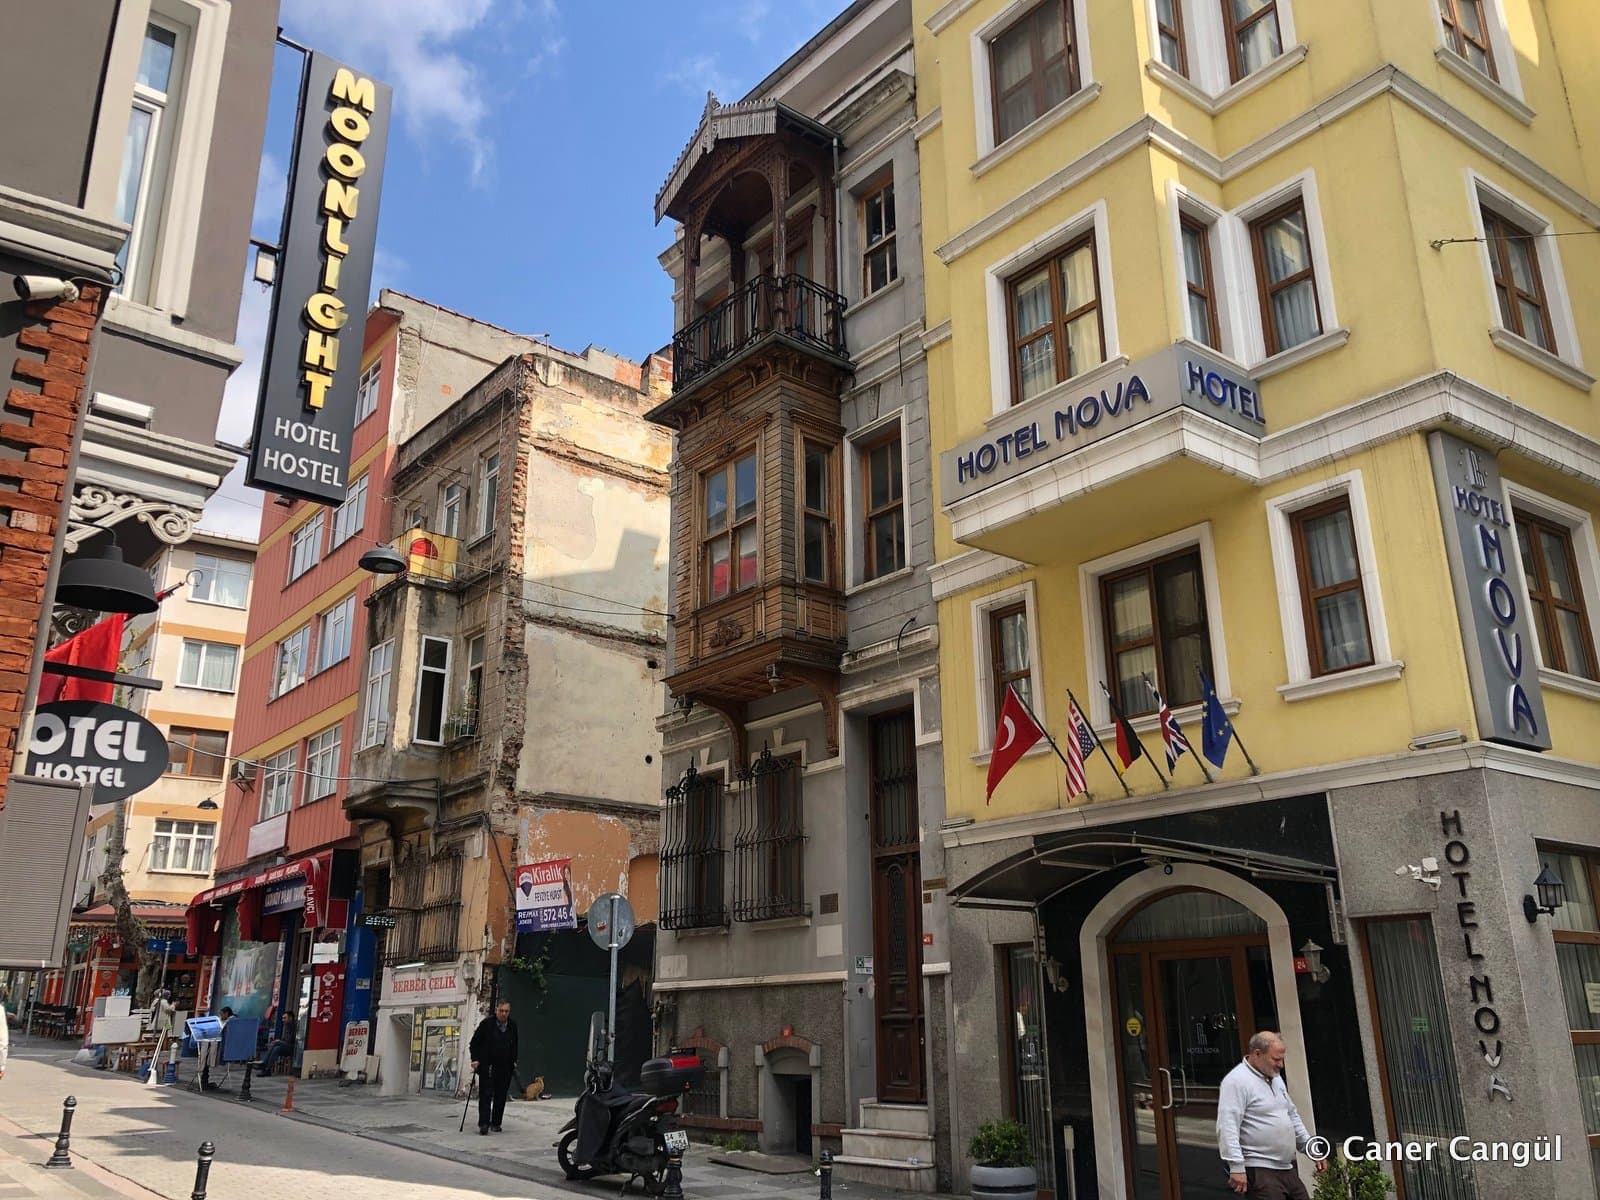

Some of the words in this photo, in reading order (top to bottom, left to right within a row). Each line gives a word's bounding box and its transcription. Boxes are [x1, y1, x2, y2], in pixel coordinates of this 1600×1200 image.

[304, 67, 375, 411] MOONLIGHT
[1185, 360, 1266, 425] HOTEL
[274, 416, 341, 454] HOTEL
[957, 421, 1048, 484] HOTEL
[1055, 375, 1151, 440] NOVA
[263, 447, 343, 488] HOSTEL
[1453, 485, 1510, 528] HOTEL
[1475, 523, 1538, 737] NOVA
[28, 712, 147, 763] OTEL
[35, 762, 126, 788] HOSTEL
[543, 908, 556, 922] 572
[558, 906, 568, 920] 46
[1440, 809, 1483, 960] HOTEL
[1469, 975, 1512, 1101] NOVA
[393, 978, 427, 993] BERBER
